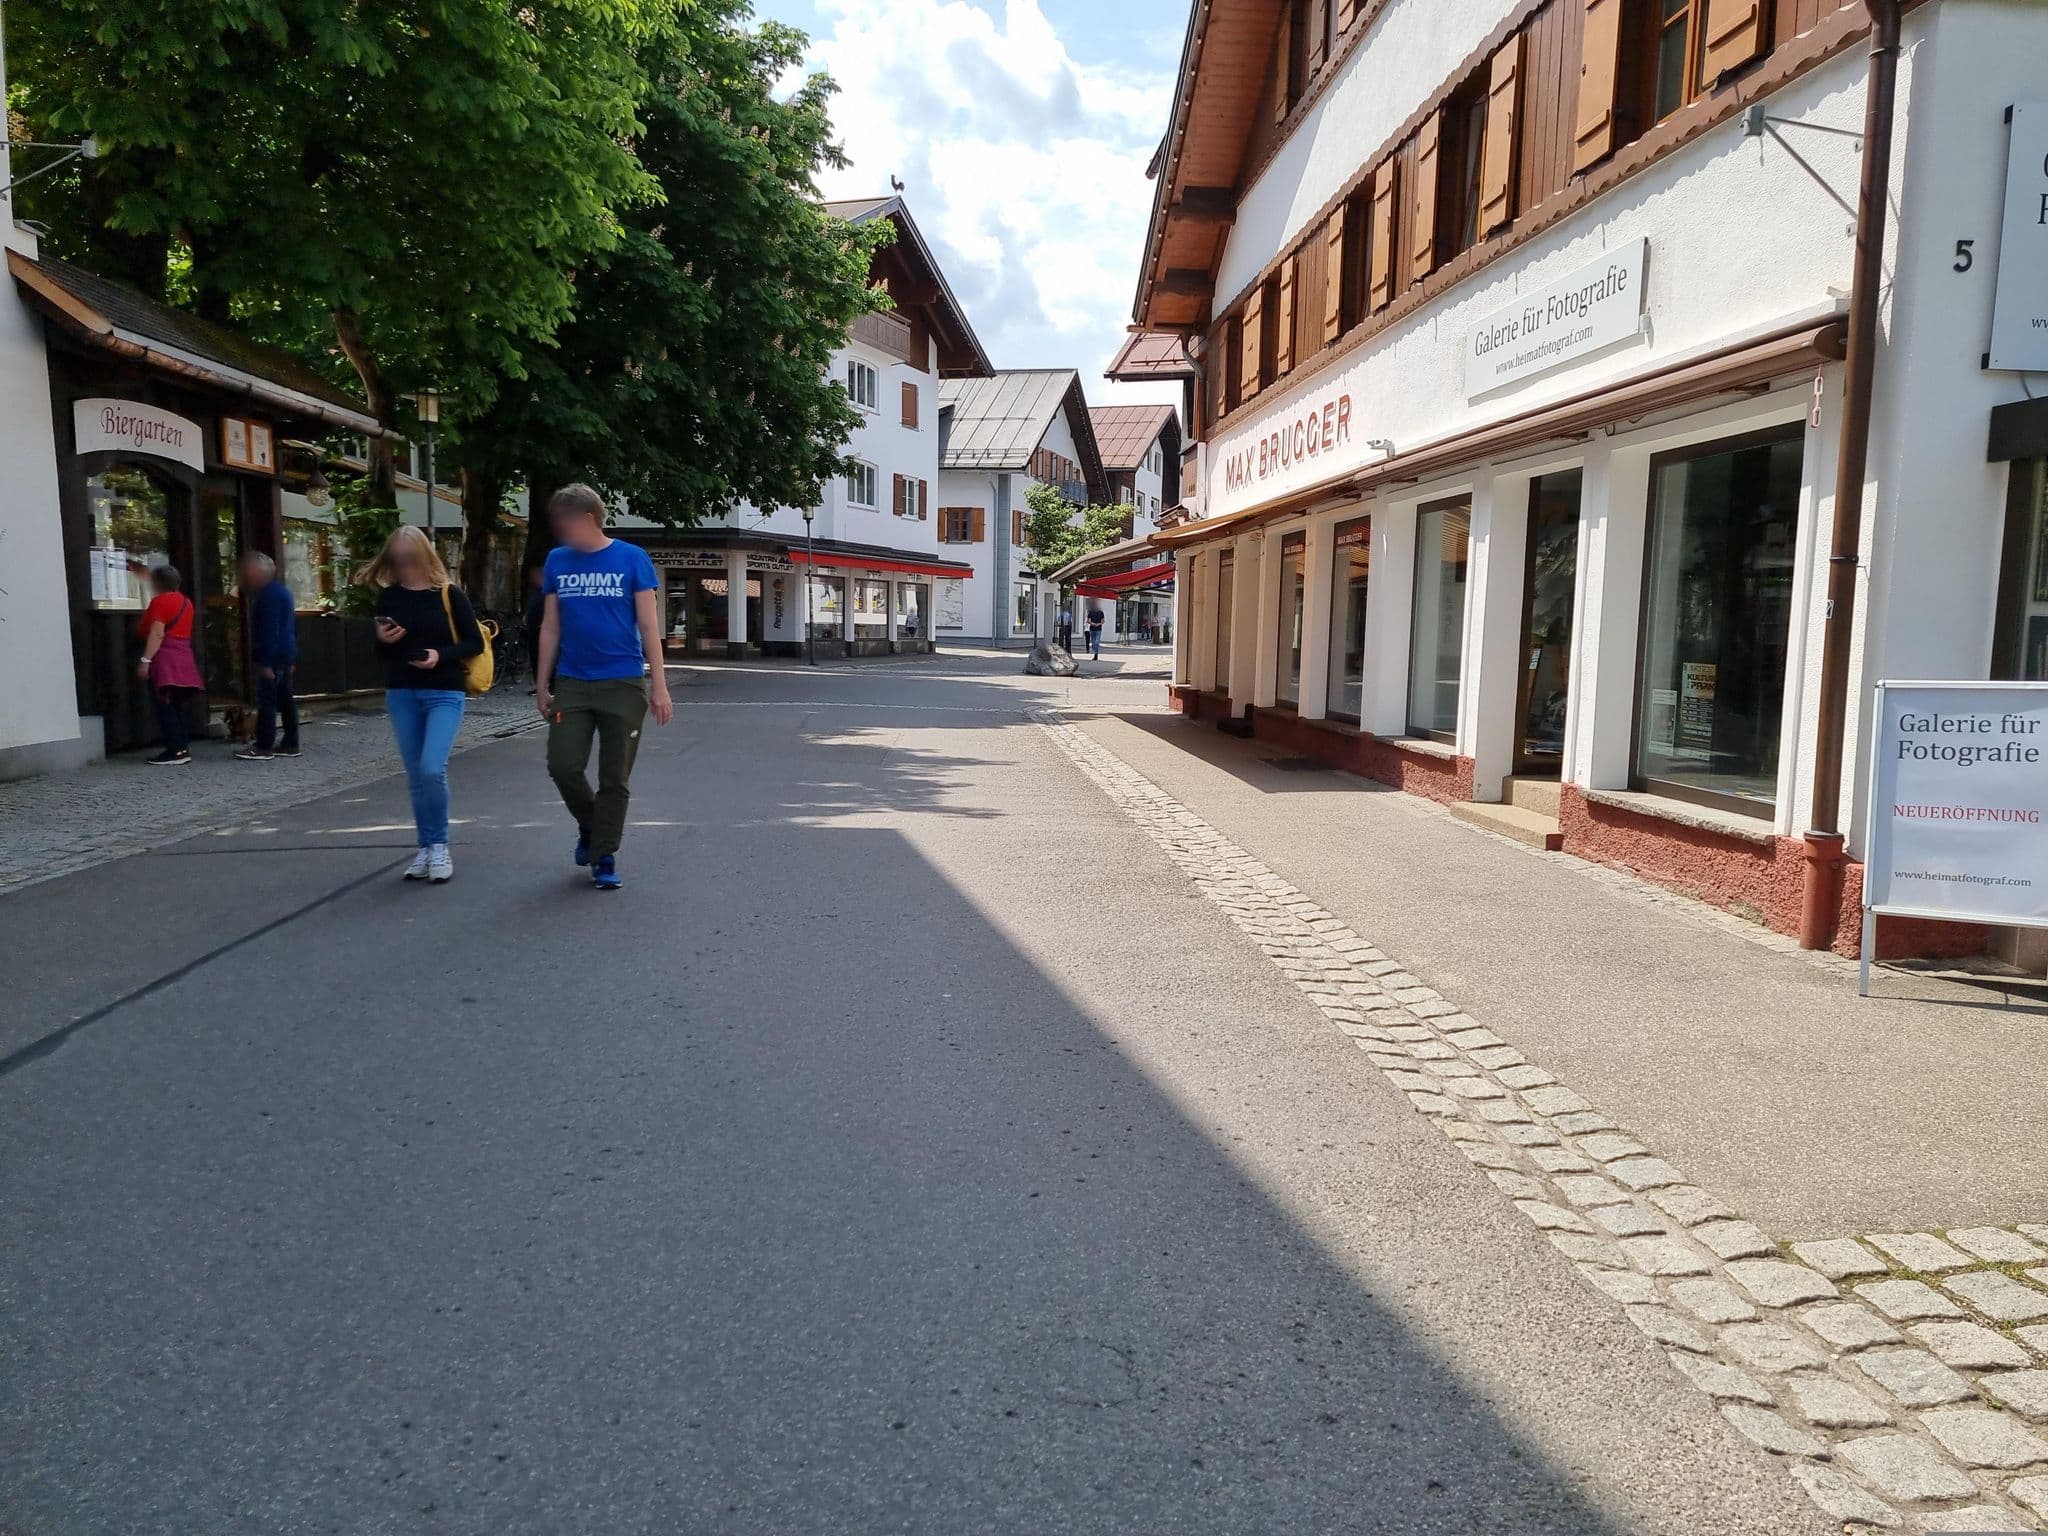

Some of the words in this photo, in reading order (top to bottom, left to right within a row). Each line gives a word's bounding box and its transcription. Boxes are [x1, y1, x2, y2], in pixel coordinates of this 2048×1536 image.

[1953, 240, 1975, 273] 5
[1475, 317, 1519, 356] Galerie
[1522, 307, 1543, 336] für
[1547, 265, 1628, 325] Fotografie
[1495, 325, 1593, 375] www.heimatfotograf.com
[101, 406, 184, 447] Biergarten
[1226, 445, 1256, 492] MAX
[1259, 394, 1352, 477] BRUGGER
[747, 554, 778, 563] MOUNTAIN
[747, 561, 771, 569] SPORTS
[772, 563, 794, 571] OUTLET
[557, 573, 624, 588] TOMMY
[581, 587, 624, 597] JEANS
[1899, 713, 1992, 733] Galerie
[2000, 714, 2040, 734] für
[1897, 740, 2039, 767] Fotografie
[1893, 804, 2040, 823] NEUERÖFFNUNG
[1894, 869, 2032, 887] www.heimatfotograf.com
